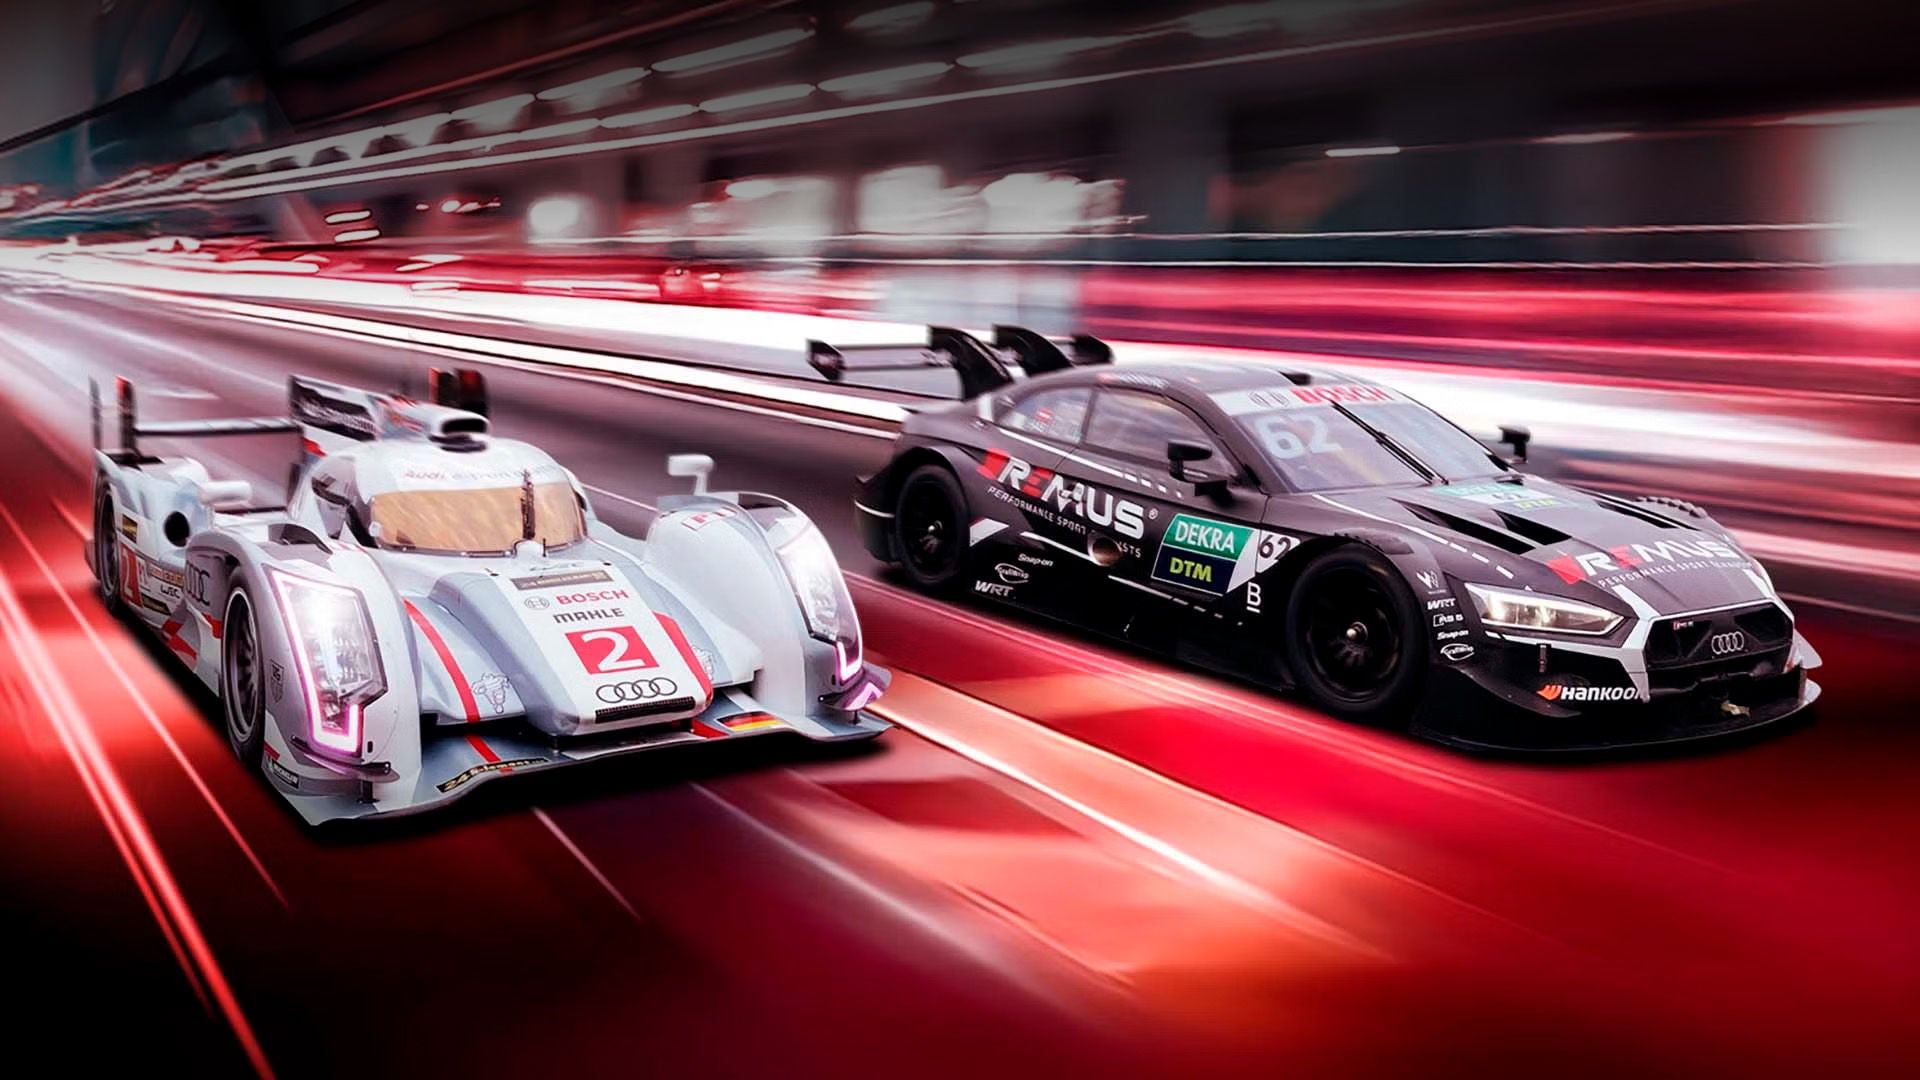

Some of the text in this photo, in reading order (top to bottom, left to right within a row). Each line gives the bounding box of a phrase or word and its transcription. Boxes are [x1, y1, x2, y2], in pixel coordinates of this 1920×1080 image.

[1289, 384, 1395, 404] BOSCH
[1254, 415, 1343, 459] 62
[987, 485, 1054, 523] PERFORMANCE
[1174, 520, 1235, 554] DEKRA
[1259, 534, 1292, 560] 62
[1169, 557, 1212, 582] DTM
[1598, 564, 1677, 588] PERFORMANCE
[555, 589, 630, 605] BOSCH
[974, 580, 1014, 597] WRT
[1427, 598, 1456, 610] WRT
[581, 630, 647, 673] 2
